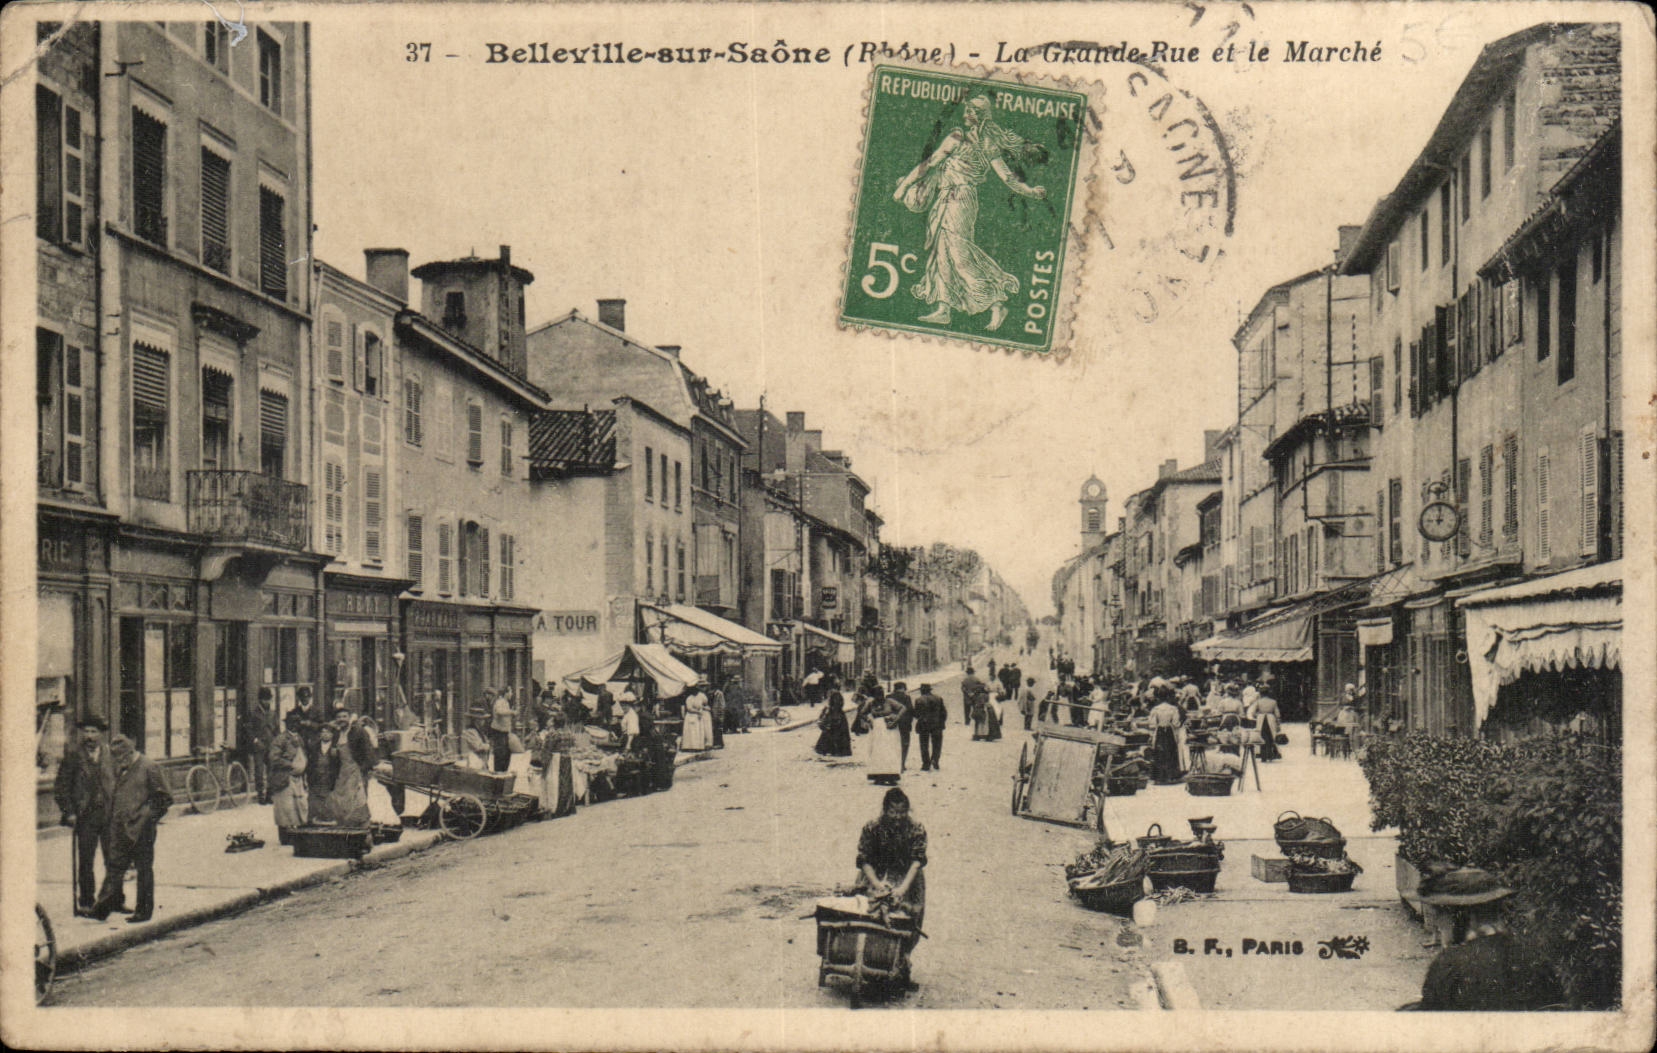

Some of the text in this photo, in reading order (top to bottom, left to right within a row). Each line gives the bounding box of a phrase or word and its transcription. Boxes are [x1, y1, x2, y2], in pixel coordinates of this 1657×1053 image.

[995, 92, 1076, 119] FRANÇAISE
[1025, 250, 1055, 334] POSTES
[554, 615, 597, 631] TOUR
